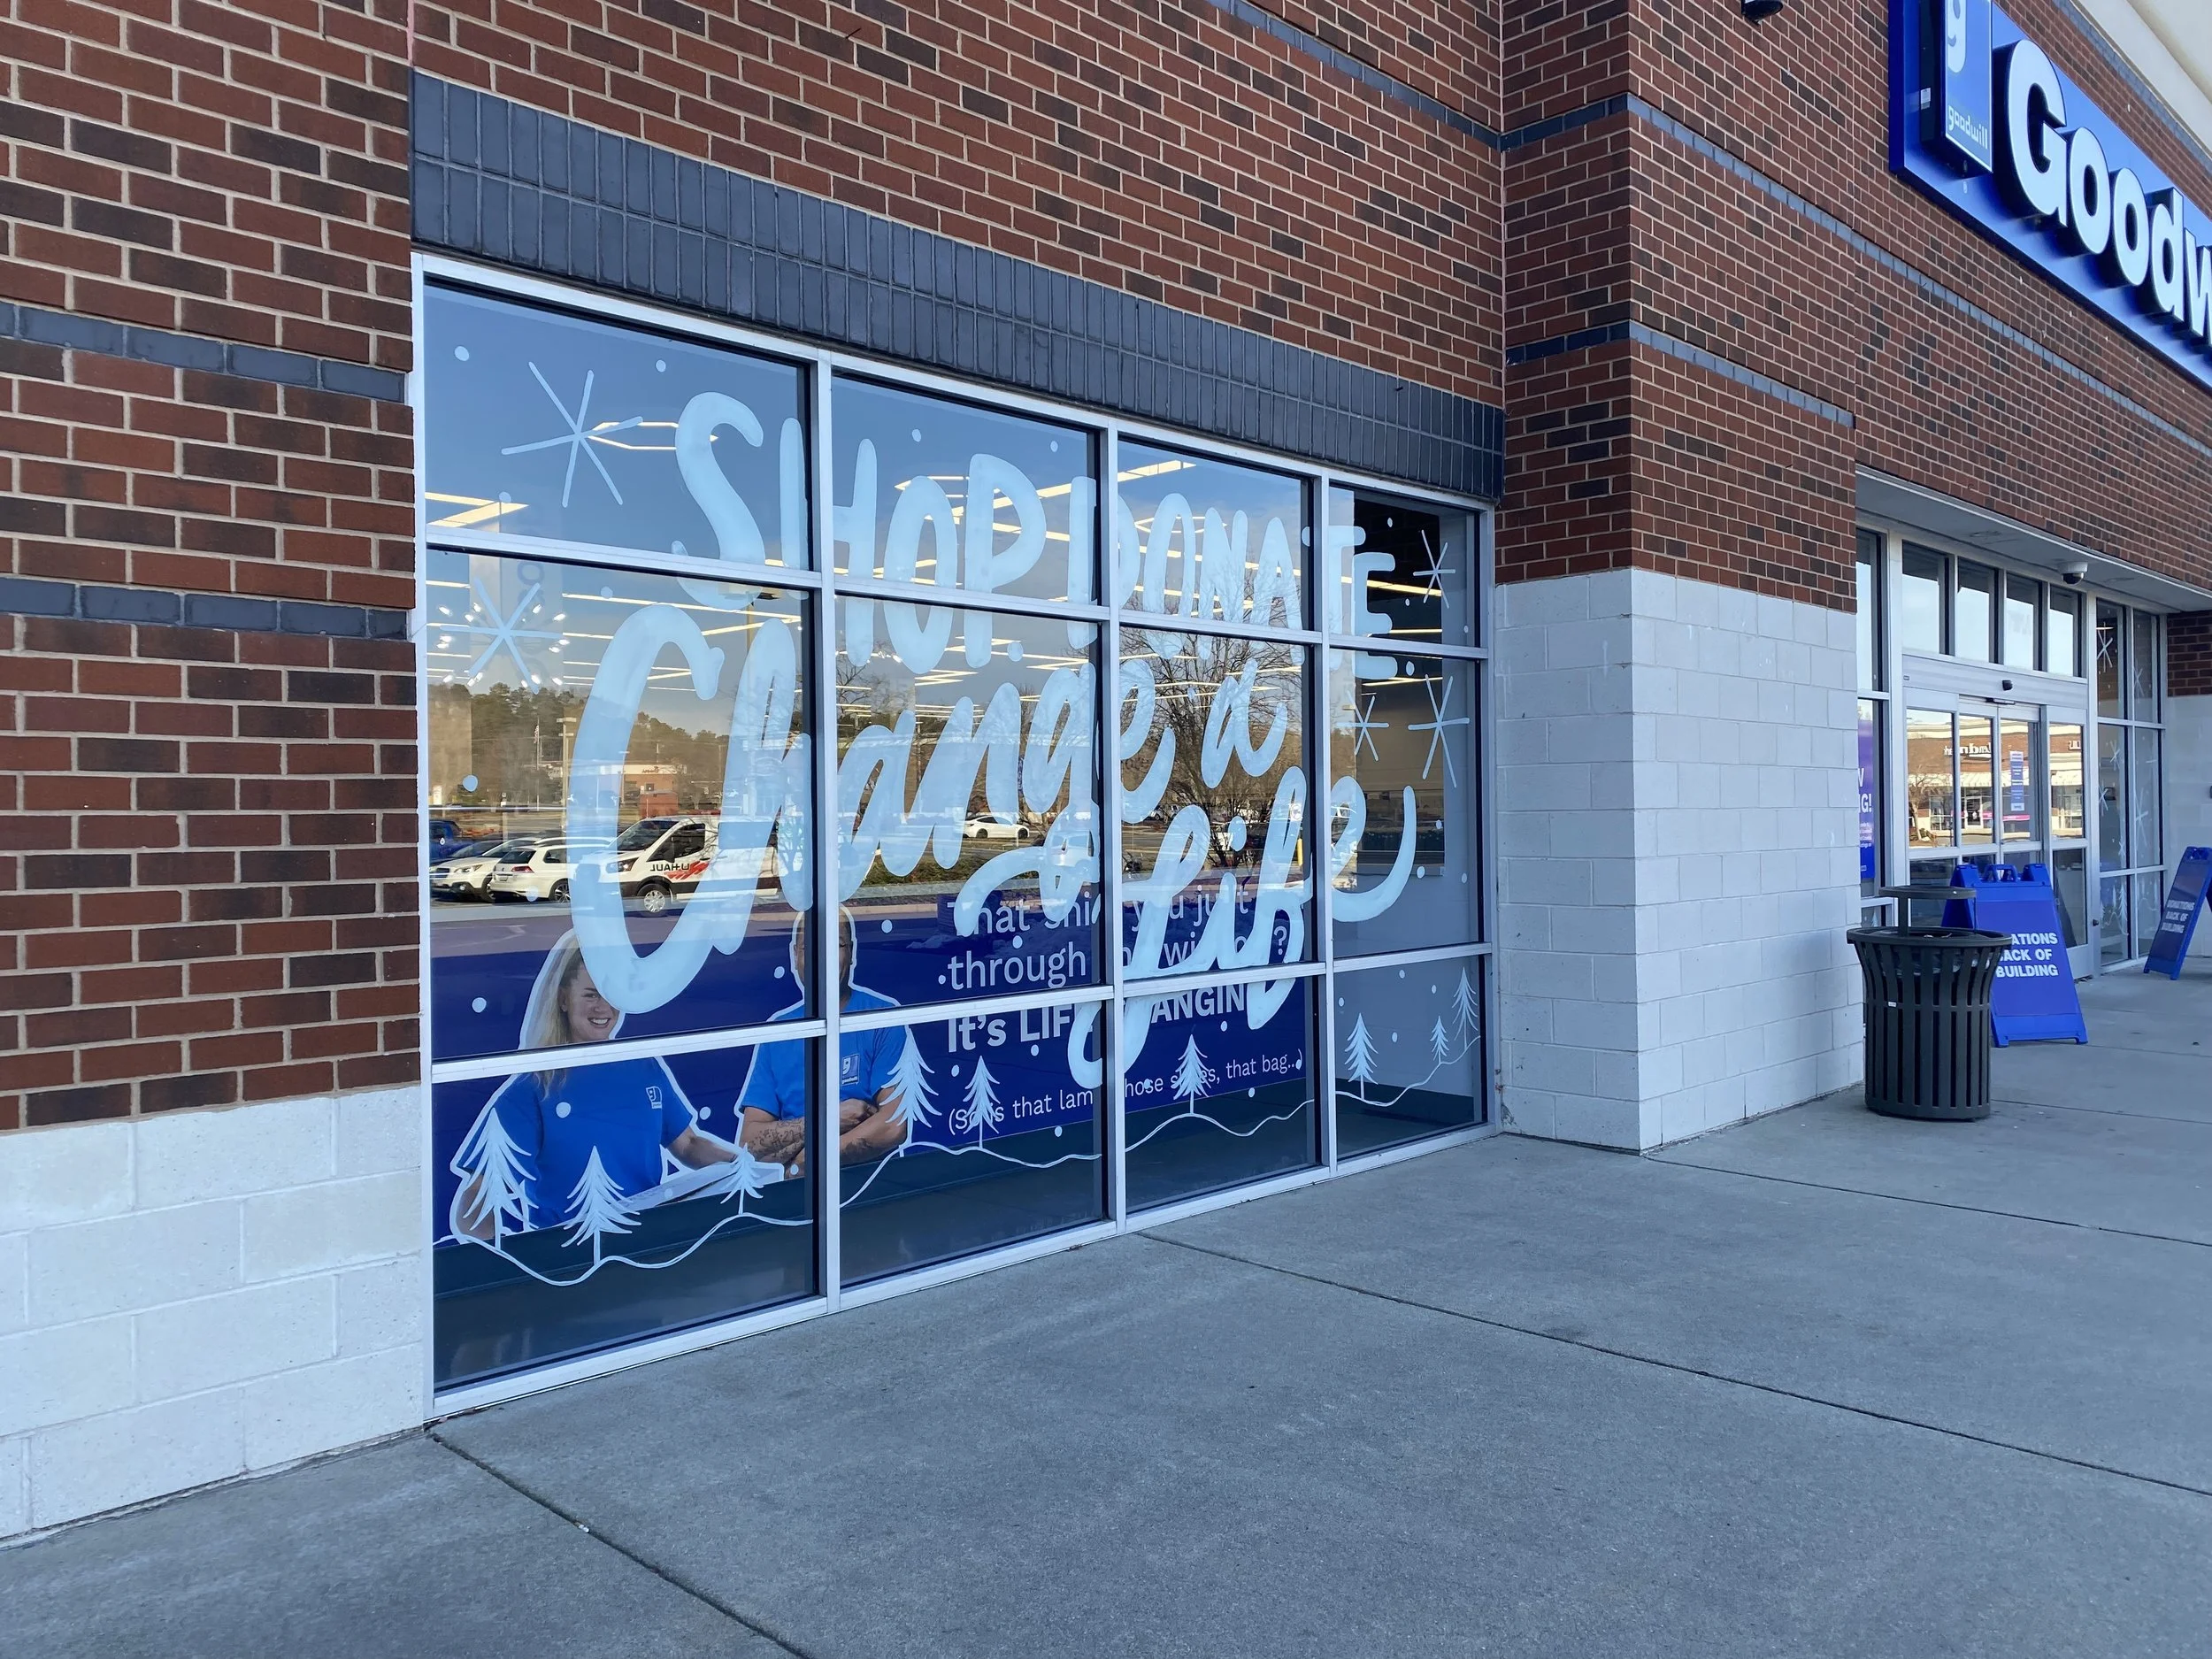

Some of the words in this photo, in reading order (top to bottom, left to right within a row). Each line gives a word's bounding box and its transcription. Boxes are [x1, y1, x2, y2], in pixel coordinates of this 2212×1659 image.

[1948, 104, 1988, 150] goodwill
[570, 603, 1176, 1014] Change
[1201, 659, 1288, 789] a
[2000, 949, 2032, 962] ACK
[2034, 949, 2053, 961] OF
[2011, 933, 2058, 946] ATIONS
[948, 941, 1087, 989] through
[1995, 964, 2059, 978] BUILDING
[948, 1015, 1007, 1053] It's
[1013, 1094, 1053, 1119] that
[1124, 1077, 1164, 1098] hose
[1225, 1058, 1256, 1079] that
